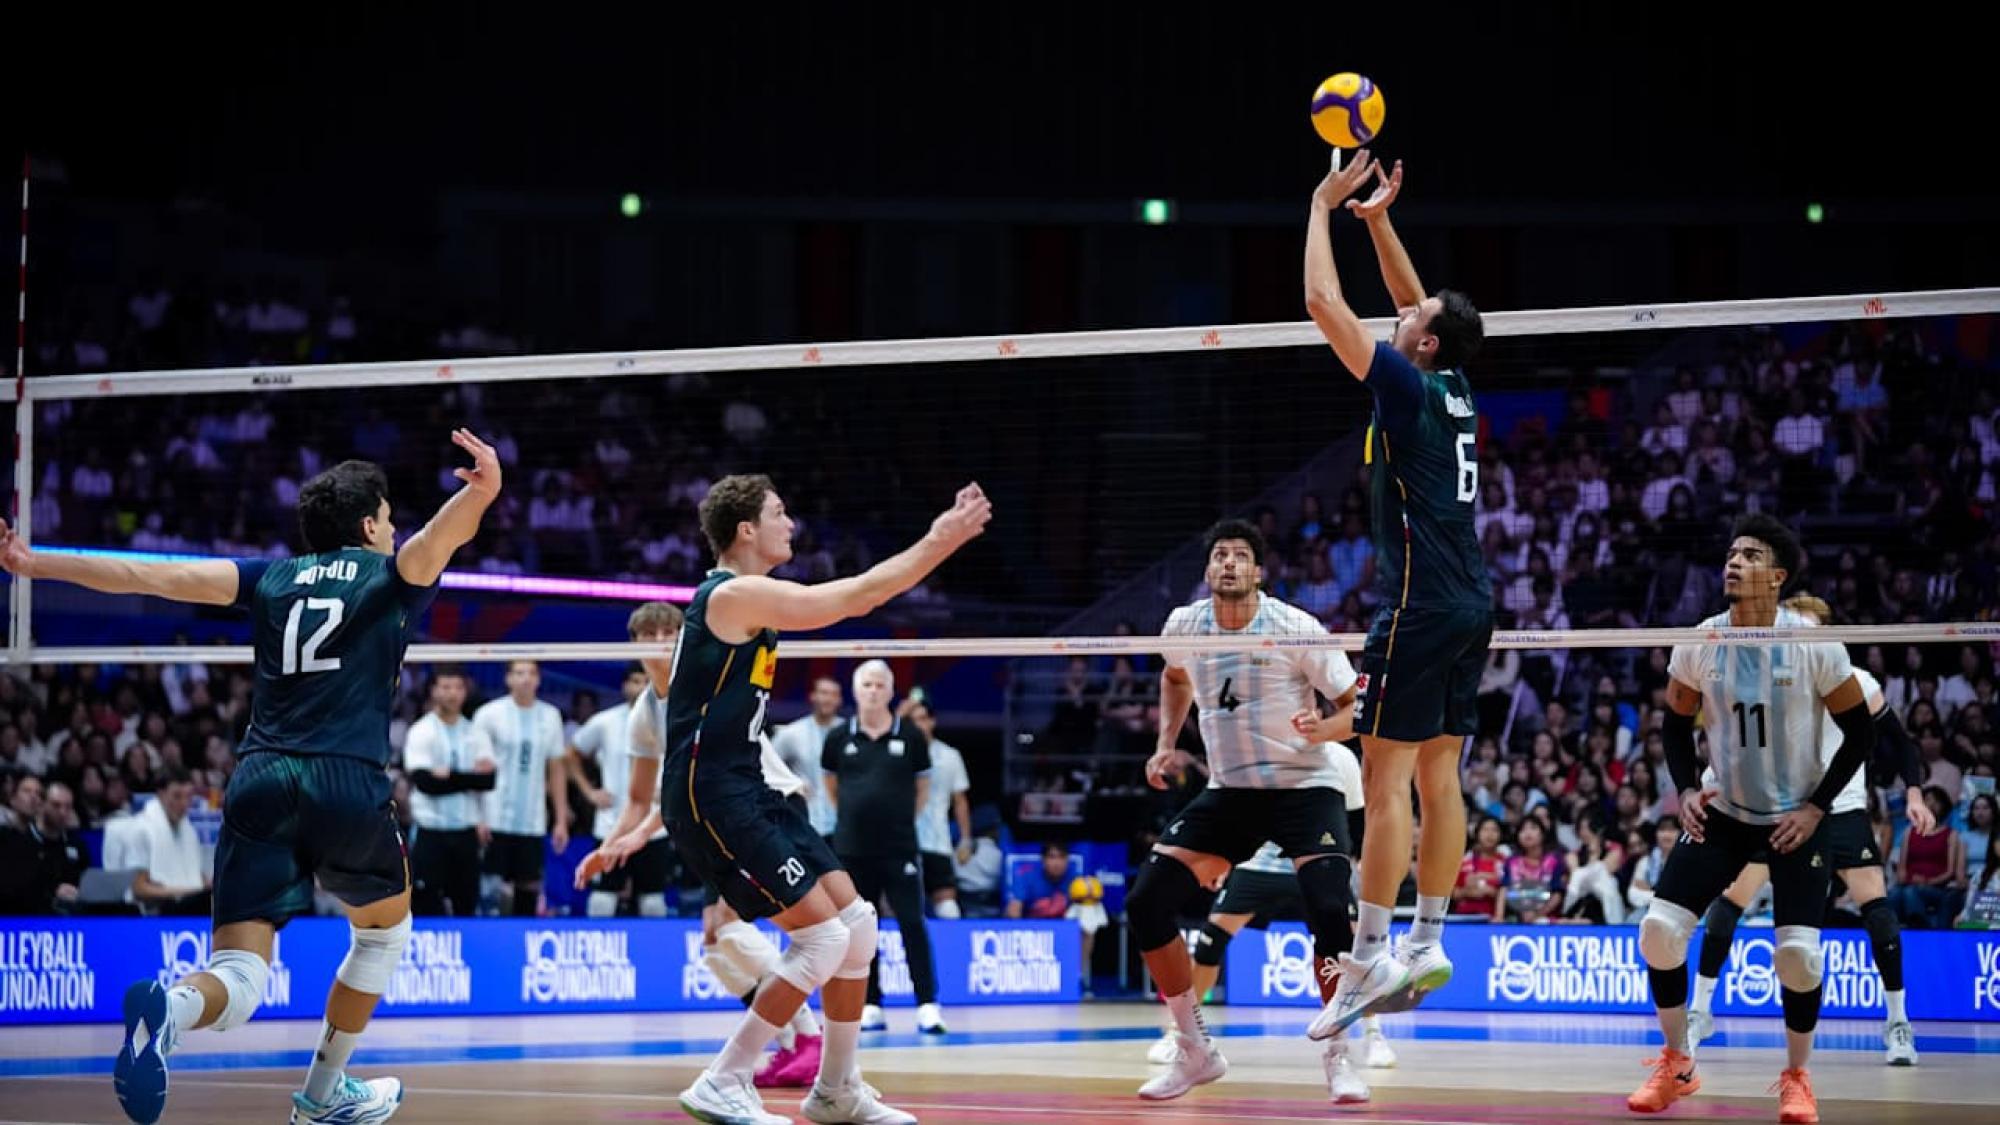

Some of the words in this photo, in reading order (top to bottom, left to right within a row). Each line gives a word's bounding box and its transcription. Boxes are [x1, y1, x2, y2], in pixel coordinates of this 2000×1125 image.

[1456, 432, 1479, 502] 6
[282, 597, 345, 675] 12
[1218, 677, 1240, 712] 4
[1733, 702, 1767, 748] 11
[777, 857, 805, 886] 20
[524, 930, 630, 966] VOLLEYBALL
[970, 930, 1057, 961] VOLLEYBALL
[1489, 934, 1640, 971] VOLLEYBALL
[521, 962, 636, 1001] FOUNDATION
[1487, 964, 1649, 1003] FOUNDATION
